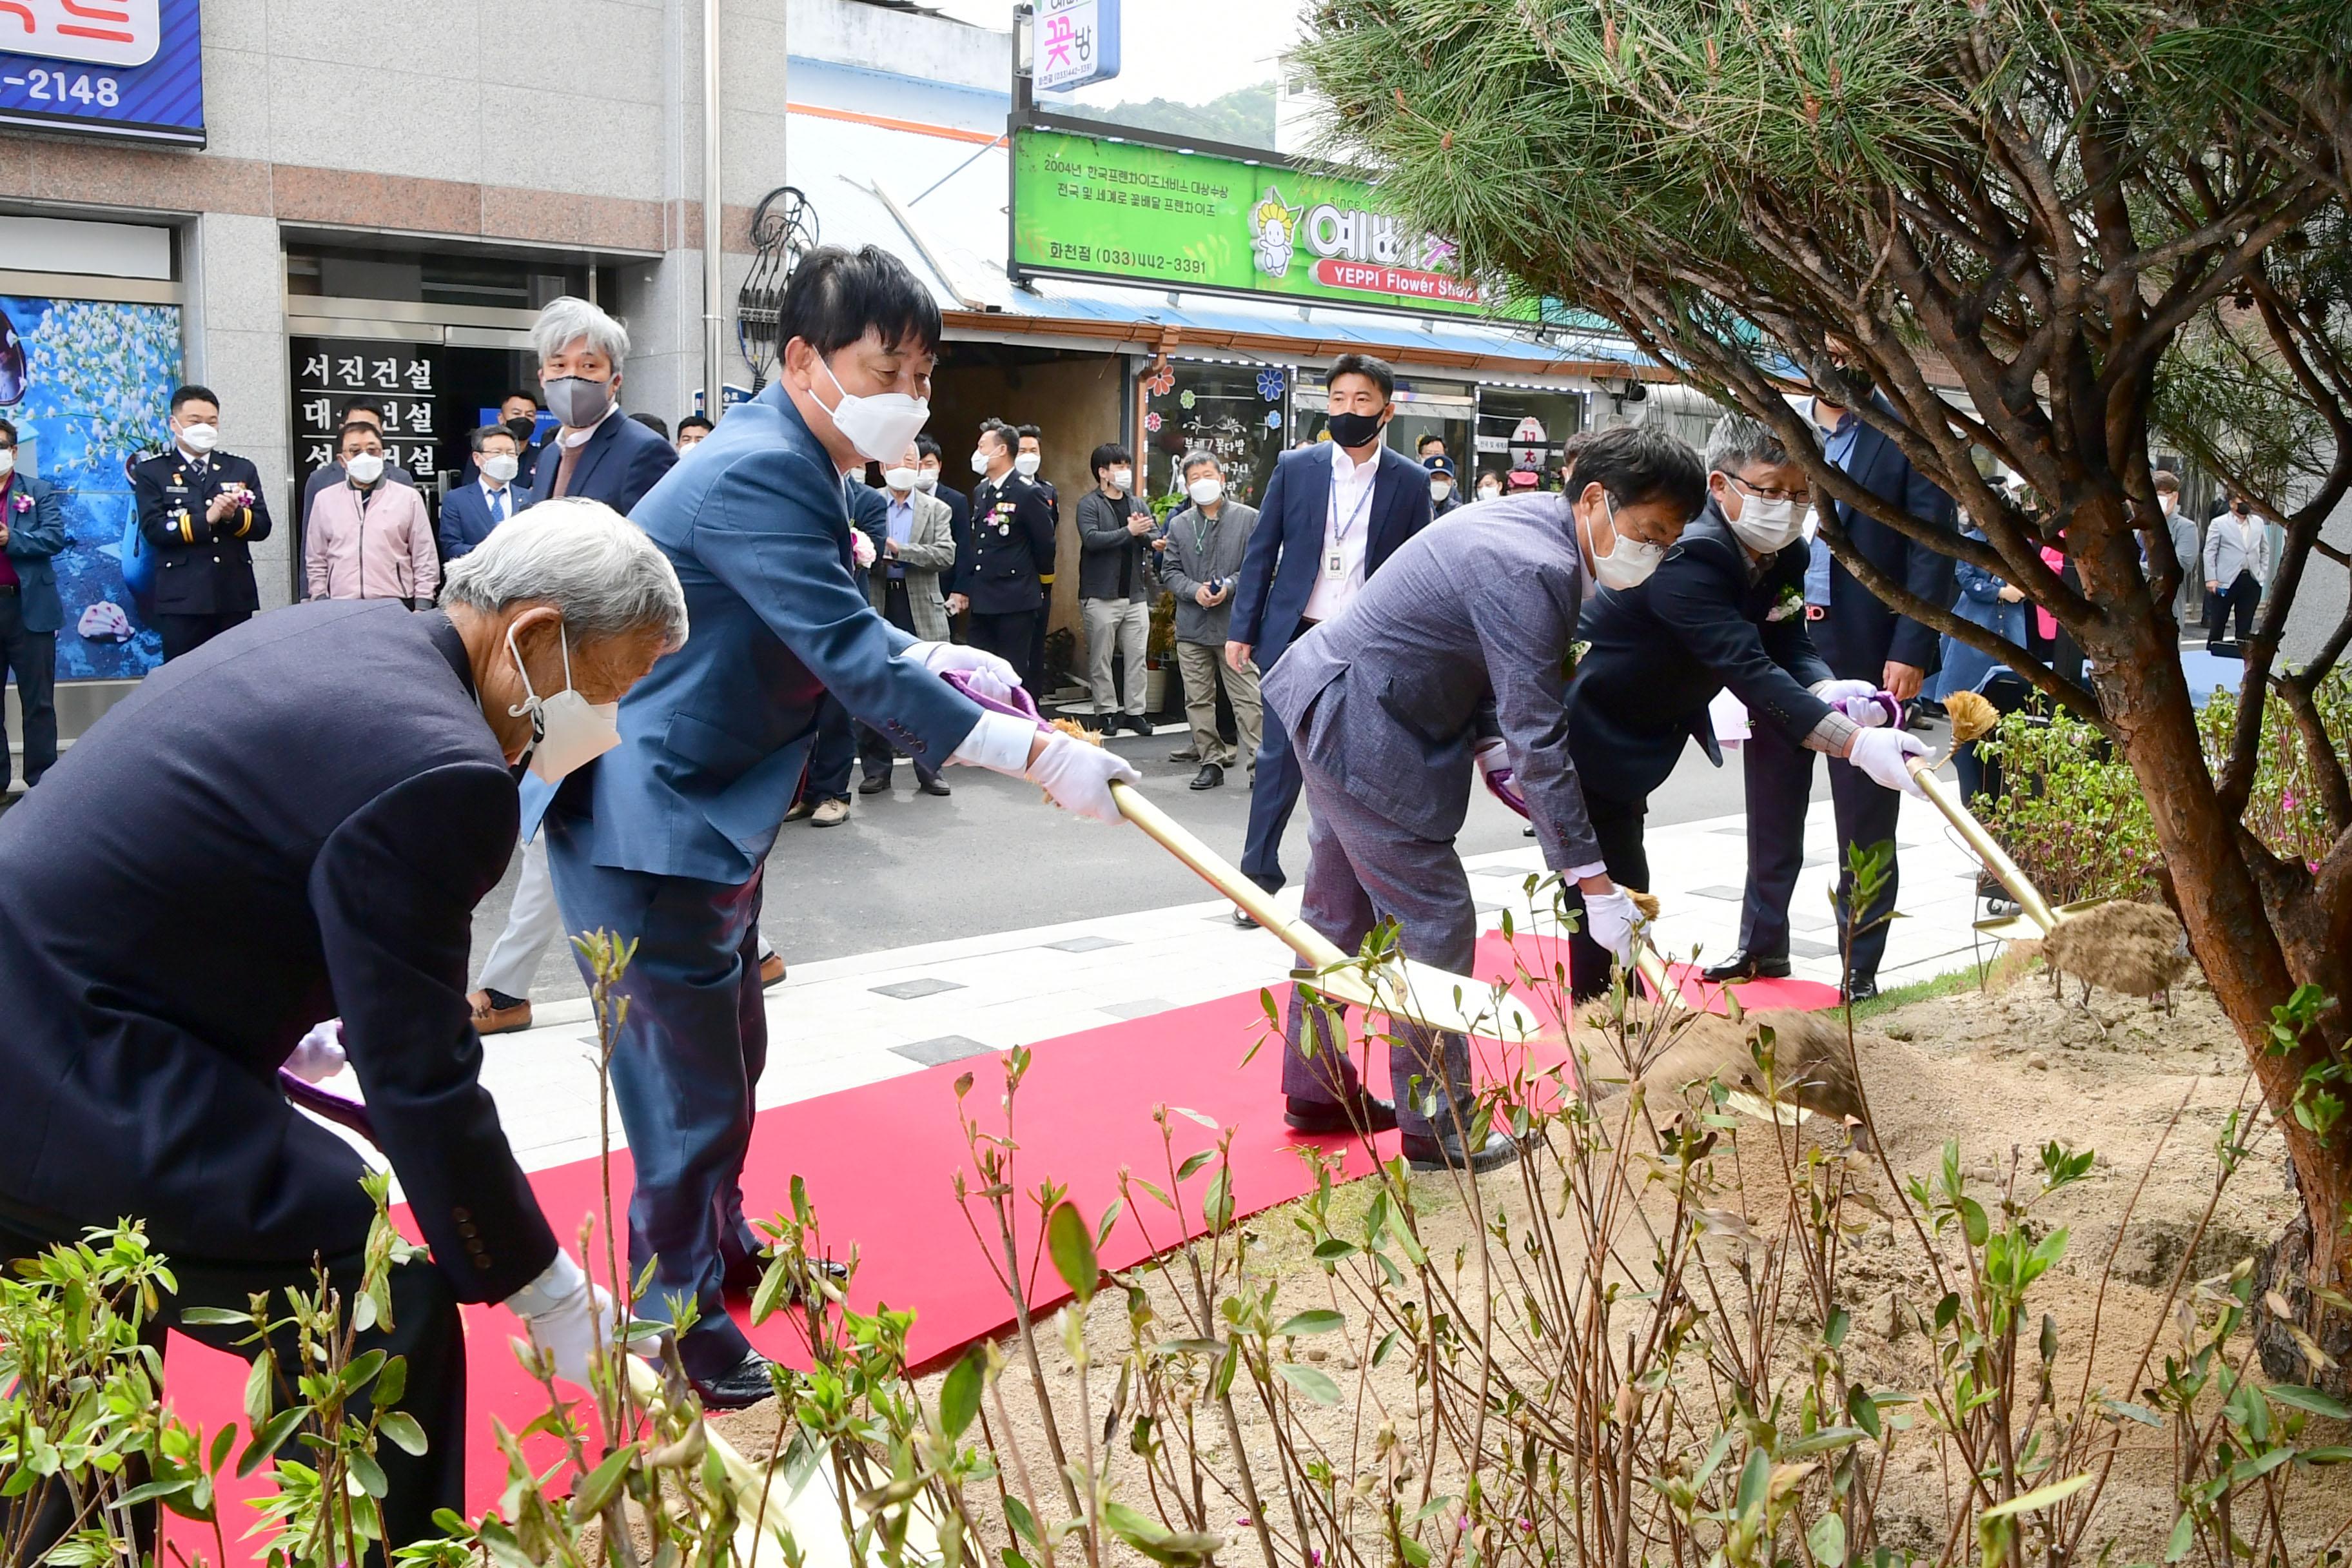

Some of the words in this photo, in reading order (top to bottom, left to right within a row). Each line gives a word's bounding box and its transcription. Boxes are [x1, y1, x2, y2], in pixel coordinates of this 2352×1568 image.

[1044, 16, 1092, 72] 꽃방
[0, 69, 119, 107] -2148
[1044, 160, 1081, 177] 2004년
[1191, 181, 1228, 199] 대상수상
[1057, 182, 1079, 198] 전국
[1083, 186, 1092, 200] 및
[1096, 190, 1127, 205] 세계로
[1131, 193, 1161, 210] 꽃배달
[1164, 198, 1215, 217] 프렌차이즈
[1329, 197, 1360, 209] since
[1050, 241, 1091, 261] 화천점
[1097, 248, 1206, 274] (033)442-3391
[1335, 266, 1379, 287] YEPPI
[1387, 273, 1434, 294] Flower
[301, 353, 432, 390] 서진건설
[302, 398, 433, 433] 대건설
[1215, 438, 1245, 455] 꽃다발
[1222, 481, 1237, 496] 란
